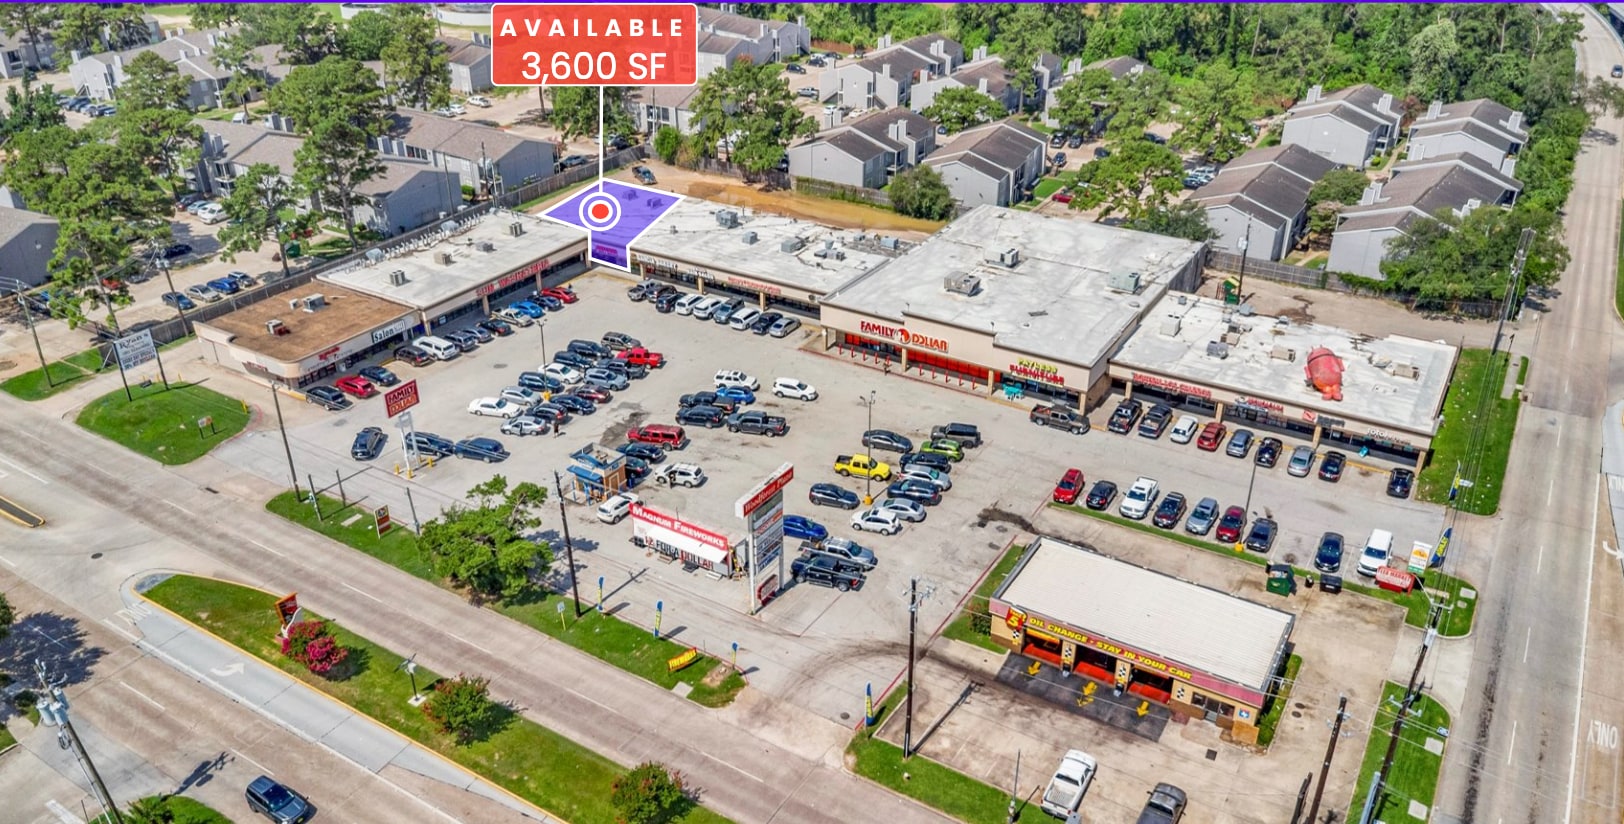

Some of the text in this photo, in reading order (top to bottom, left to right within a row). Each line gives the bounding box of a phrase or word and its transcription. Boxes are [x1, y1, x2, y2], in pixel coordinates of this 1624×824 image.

[373, 327, 395, 342] Salon
[860, 321, 948, 351] FAMILY DOLLAR
[388, 385, 414, 404] FAMILY
[1008, 615, 1019, 627] 5
[1029, 617, 1045, 628] OIL
[1047, 624, 1088, 644] CHANGE
[1095, 641, 1122, 655] STAY
[1123, 650, 1136, 660] IN
[1138, 655, 1167, 672] YOUR
[1168, 667, 1193, 680] CAR
[1587, 719, 1618, 749] ONLY
